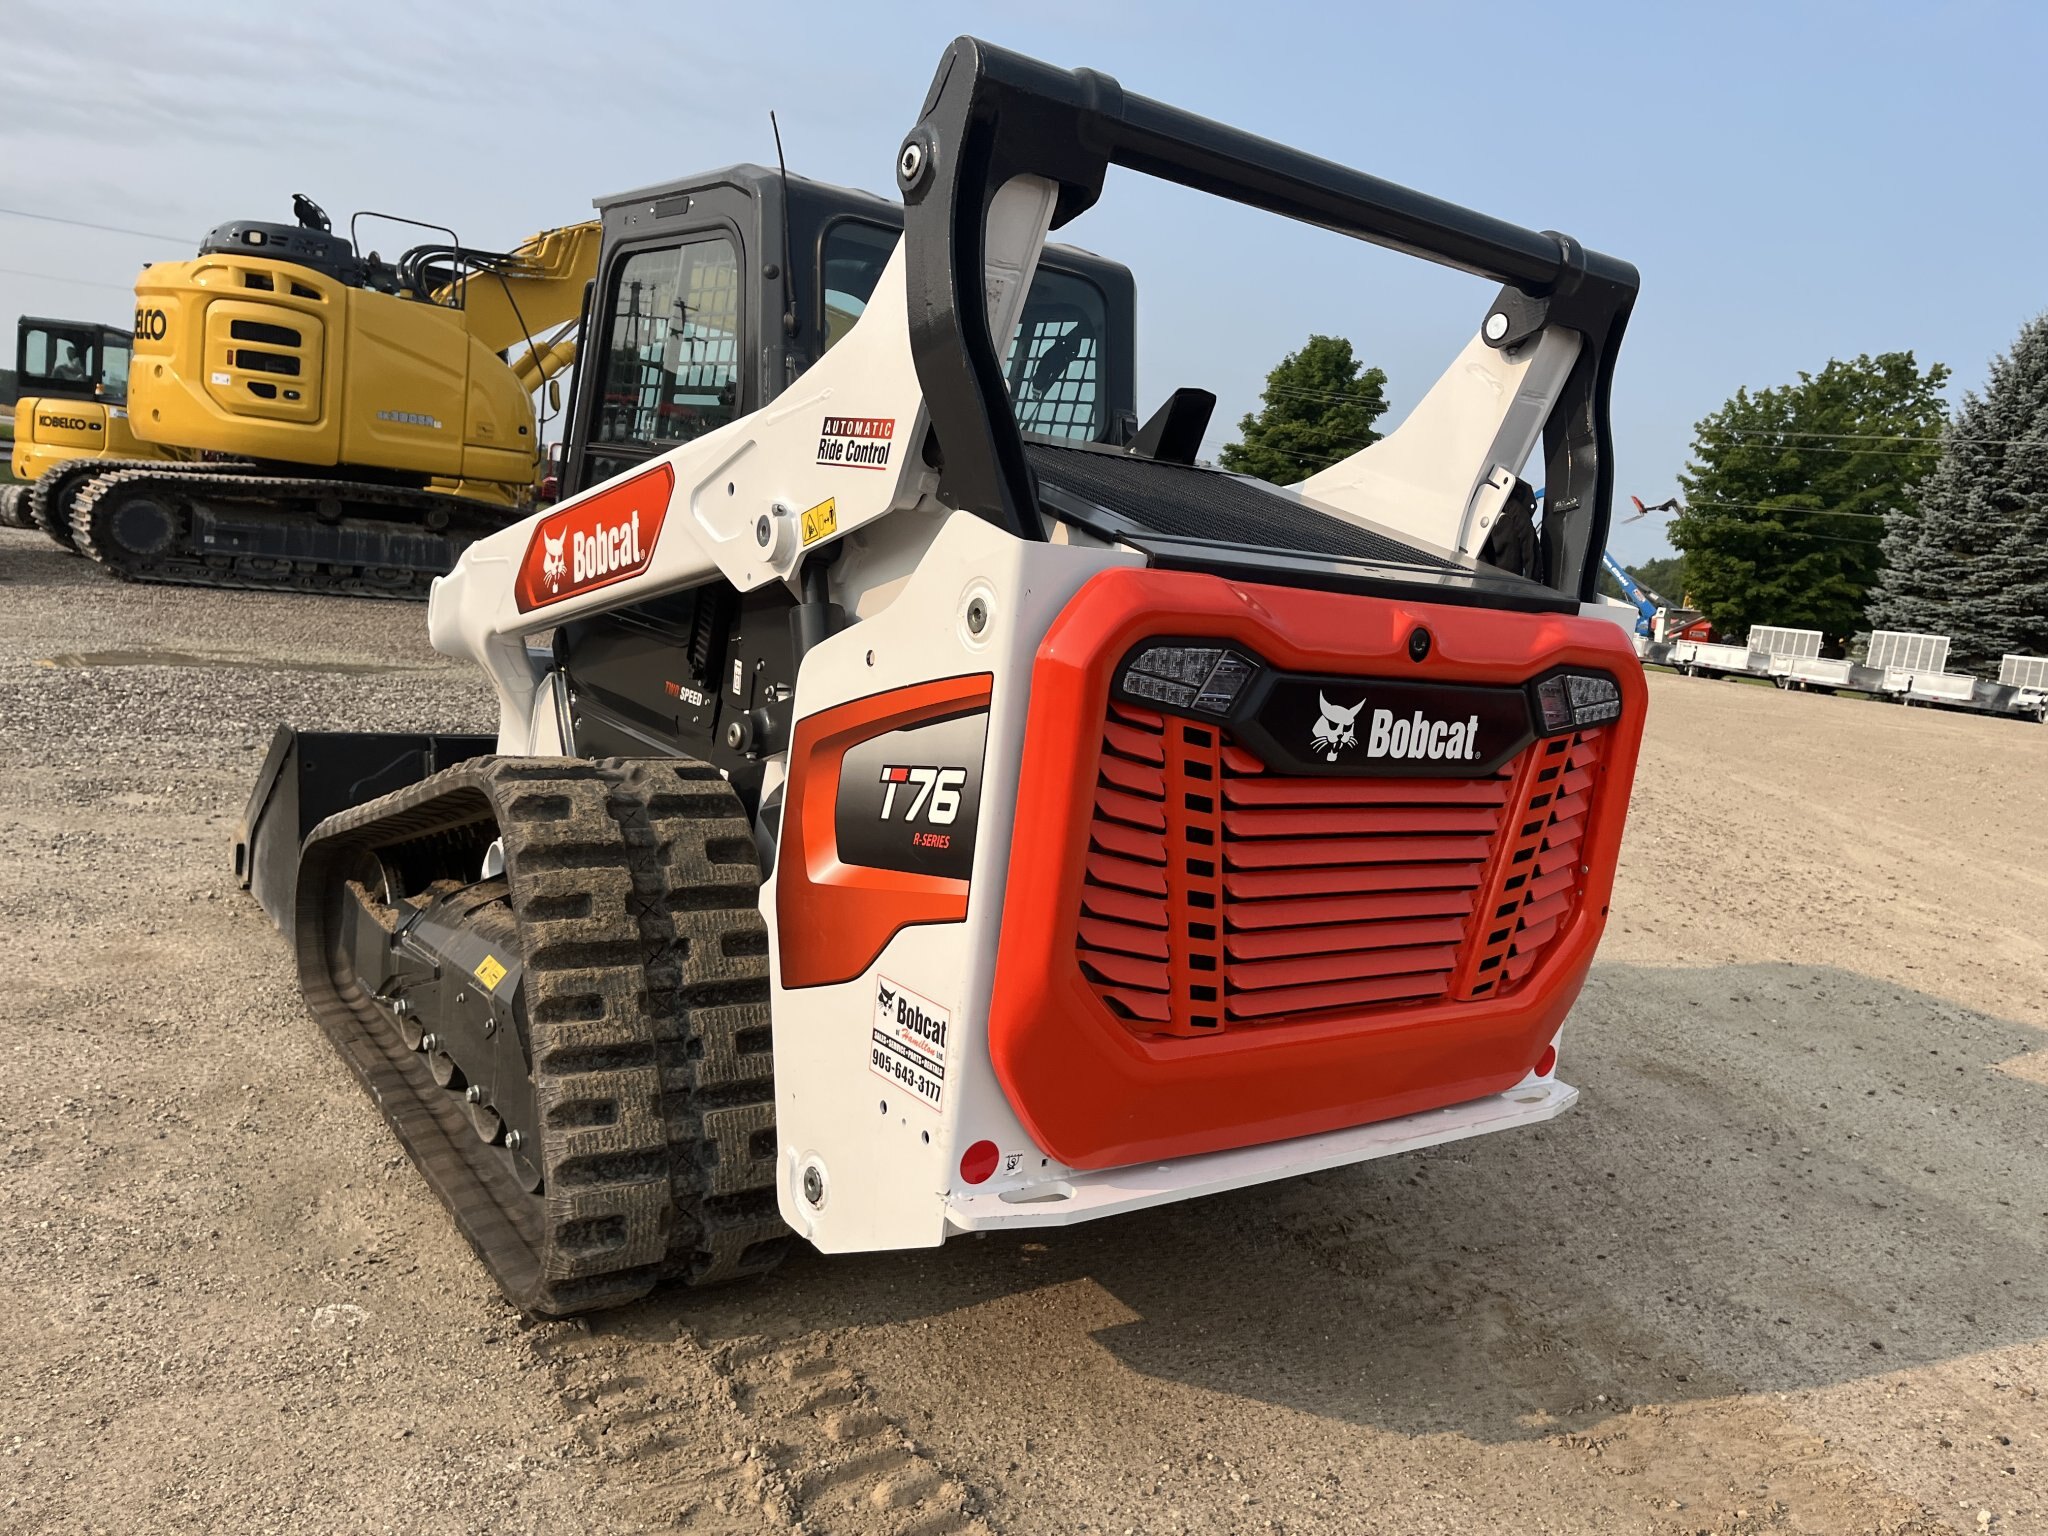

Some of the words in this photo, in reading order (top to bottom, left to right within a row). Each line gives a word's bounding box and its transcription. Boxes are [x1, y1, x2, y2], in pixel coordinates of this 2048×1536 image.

[39, 415, 87, 430] KOBELCO
[824, 420, 892, 437] AUTOMATIC
[817, 438, 844, 461] Ride
[845, 439, 892, 465] Control
[573, 509, 641, 584] Bobcat
[665, 681, 680, 698] TWO
[680, 686, 703, 707] SPEED
[1367, 708, 1479, 760] Bobcat
[880, 766, 967, 825] T76
[913, 832, 951, 849] R-SERIES
[896, 996, 947, 1048] Bobcat
[901, 1027, 936, 1056] Hamilton
[872, 1048, 942, 1103] 905-643-3177
